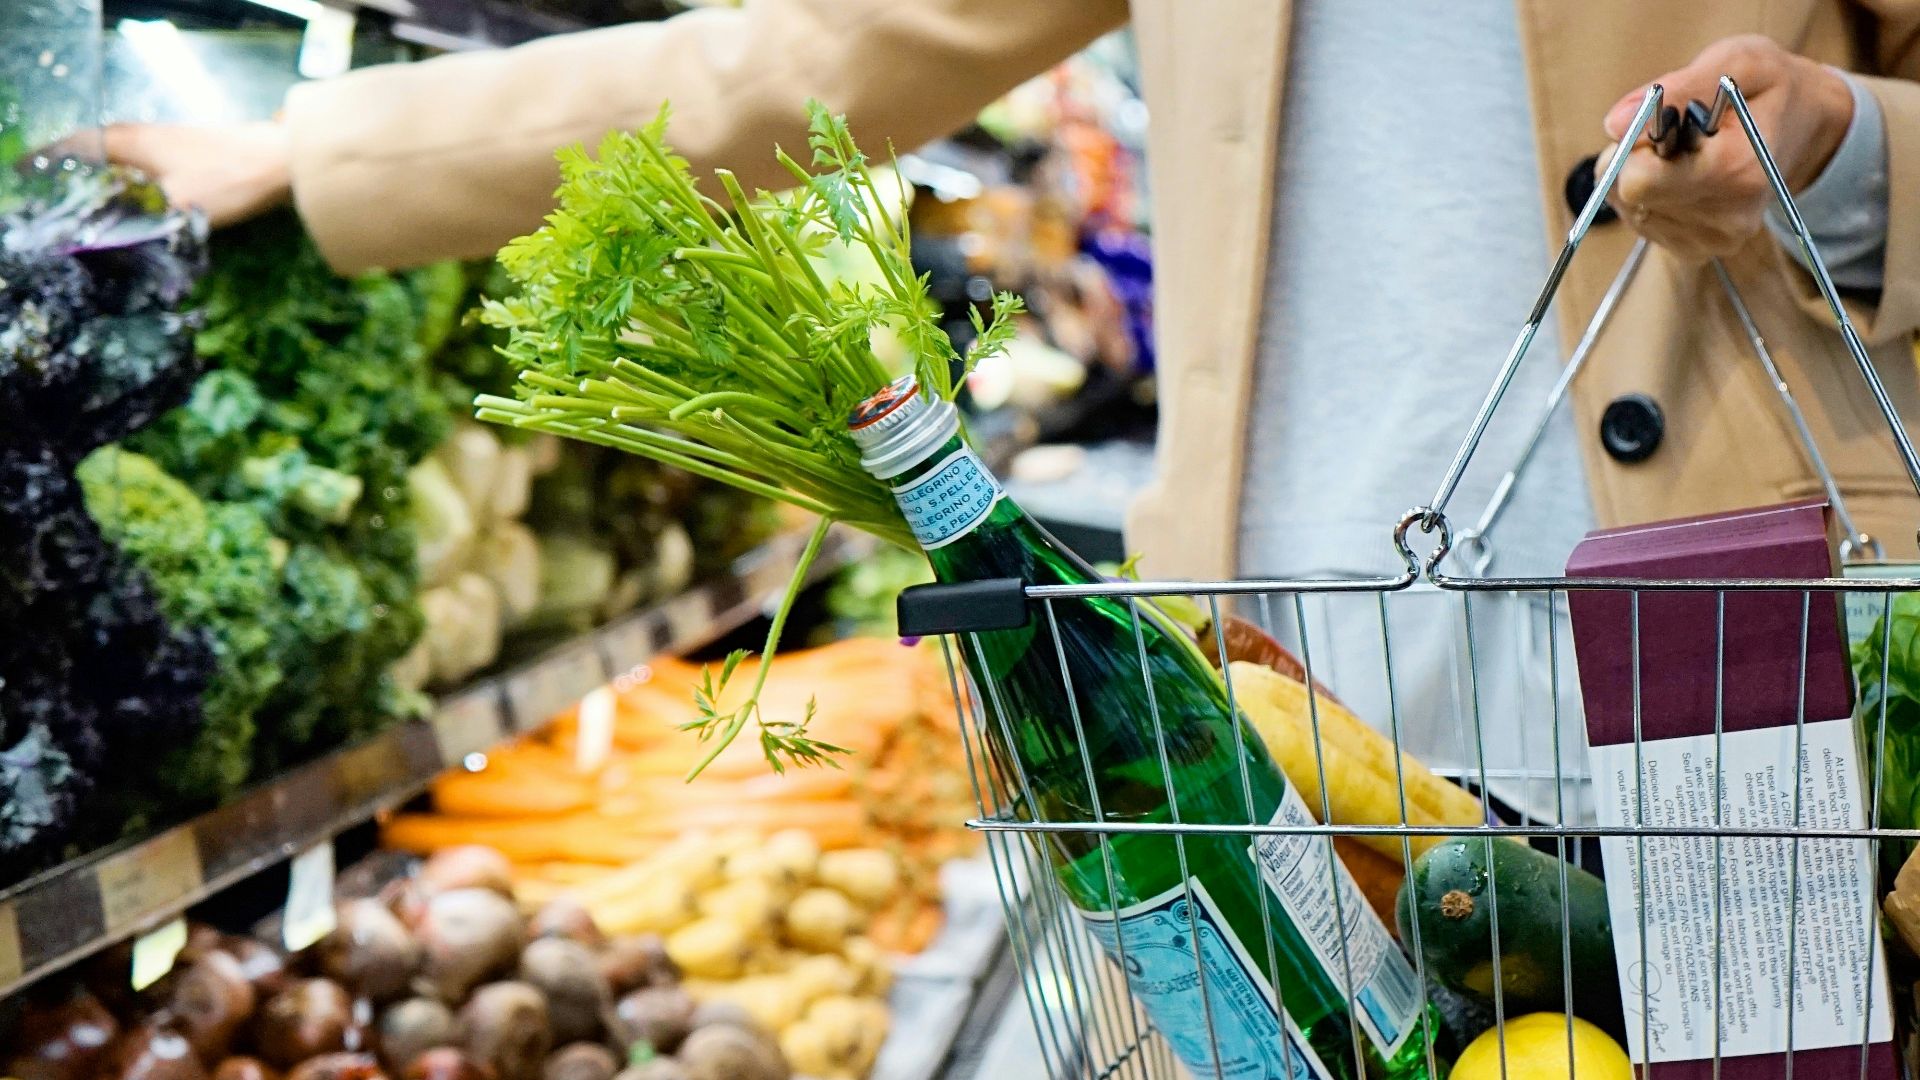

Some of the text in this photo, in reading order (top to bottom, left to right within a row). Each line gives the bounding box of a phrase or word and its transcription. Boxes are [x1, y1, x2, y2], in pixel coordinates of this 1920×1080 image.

[1683, 752, 1693, 774] Seul
[1836, 756, 1844, 767] At
[1617, 771, 1626, 792] vous
[1649, 760, 1662, 802] Délicieux
[1686, 776, 1693, 788] un
[1746, 772, 1757, 807] cheese
[1756, 772, 1766, 787] but
[1766, 766, 1777, 792] these
[1835, 770, 1849, 800] Lesley
[1621, 795, 1628, 806] ne
[1756, 790, 1769, 815] really
[1806, 787, 1816, 803] her
[1655, 805, 1663, 818] au
[1686, 790, 1700, 823] produit
[1751, 810, 1757, 819] or
[1768, 794, 1782, 826] unique
[1782, 801, 1794, 832] CRIS
[1819, 800, 1827, 815] are
[1809, 805, 1819, 830] team
[1762, 817, 1773, 841] she
[1626, 846, 1638, 866] plus
[1650, 845, 1658, 858] de
[1682, 836, 1696, 871] pouvait
[1766, 844, 1776, 869] when
[1775, 833, 1787, 868] ackers
[1825, 846, 1835, 866] with
[1846, 837, 1856, 856] ine
[1662, 857, 1670, 873] ces
[1672, 852, 1684, 883] POUR
[1802, 845, 1814, 878] scratch
[1815, 857, 1825, 872] the
[1696, 766, 1704, 789] avec
[1702, 816, 1709, 828] en
[1724, 982, 1733, 994] de
[1731, 858, 1742, 887] Foods
[1747, 870, 1755, 885] are
[1758, 868, 1768, 883] We
[1780, 870, 1788, 886] are
[1823, 748, 1865, 1017] delicious food. The fabulous crisps from Lesley's kitchen
[1828, 868, 1836, 889] care
[1849, 858, 1860, 888] Foods
[1689, 873, 1702, 914] satisfaire
[1767, 872, 1781, 904] topped
[1805, 881, 1818, 906] using
[1816, 875, 1827, 894] only
[1831, 891, 1839, 899] in
[1663, 875, 1679, 923] craquelins
[1677, 885, 1687, 907] CES
[1722, 878, 1734, 917] fabuleux
[1735, 889, 1746, 917] adore
[1750, 888, 1758, 908] sure
[1818, 896, 1828, 914] way
[1853, 890, 1860, 904] we
[1658, 908, 1667, 921] de
[1680, 909, 1690, 933] FINS
[1704, 901, 1713, 926] avec
[1751, 911, 1761, 928] you
[1763, 904, 1776, 943] addicted
[1774, 906, 1784, 925] with
[1823, 917, 1832, 926] to
[1833, 902, 1843, 927] small
[1855, 906, 1865, 926] love
[1672, 925, 1682, 945] sont
[1693, 916, 1706, 946] Lesley
[1707, 925, 1717, 943] des
[1737, 919, 1752, 960] fabriquer
[1756, 930, 1765, 944] will
[1775, 928, 1785, 948] your
[1813, 926, 1824, 951] finest
[1825, 928, 1835, 954] make
[1658, 923, 1672, 961] fromage
[1725, 919, 1741, 967] craquelins
[1769, 946, 1777, 955] to
[1856, 928, 1869, 962] making
[1699, 948, 1708, 958] et
[1758, 947, 1767, 959] be
[1666, 963, 1673, 975] ou
[1683, 935, 1700, 1003] CRAQUELINS
[1701, 961, 1709, 977] son
[1745, 962, 1753, 971] et
[1771, 957, 1780, 974] this
[1734, 969, 1744, 989] sont
[1746, 973, 1755, 995] vous
[1827, 965, 1840, 989] great
[1771, 976, 1783, 1010] yummy
[1797, 993, 1805, 1013] own
[1749, 997, 1760, 1018] offrir
[1831, 991, 1844, 1027] product
